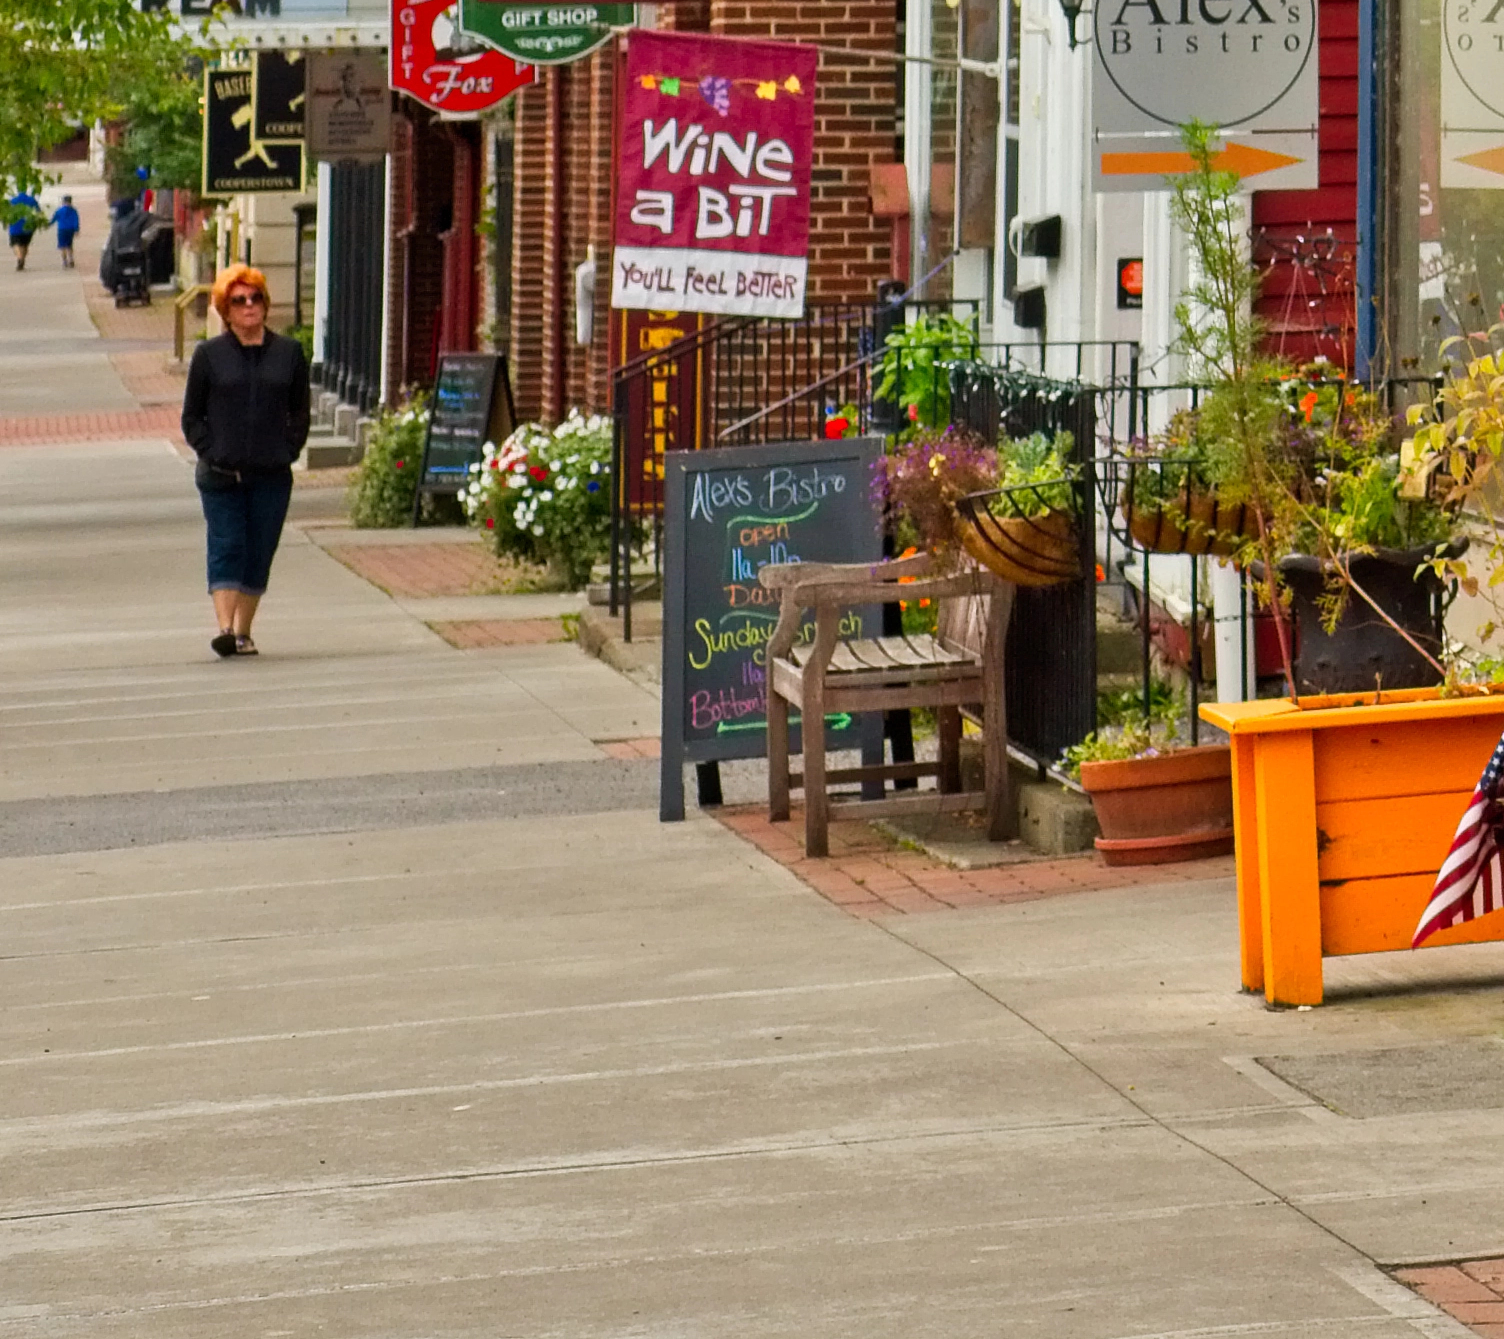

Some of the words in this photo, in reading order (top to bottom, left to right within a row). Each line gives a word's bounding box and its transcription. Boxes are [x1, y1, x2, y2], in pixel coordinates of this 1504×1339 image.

[501, 12, 542, 28] GIFT
[547, 9, 598, 26] SHOP
[1111, 28, 1301, 55] Bistro
[422, 64, 495, 104] Fox
[643, 118, 794, 182] WiNe
[631, 189, 673, 234] a
[695, 184, 798, 239] BiT
[621, 261, 675, 292] You'LL
[684, 266, 728, 296] FeeL
[736, 271, 797, 299] BeTTeR
[758, 467, 847, 514] Bistro
[739, 522, 790, 547] open
